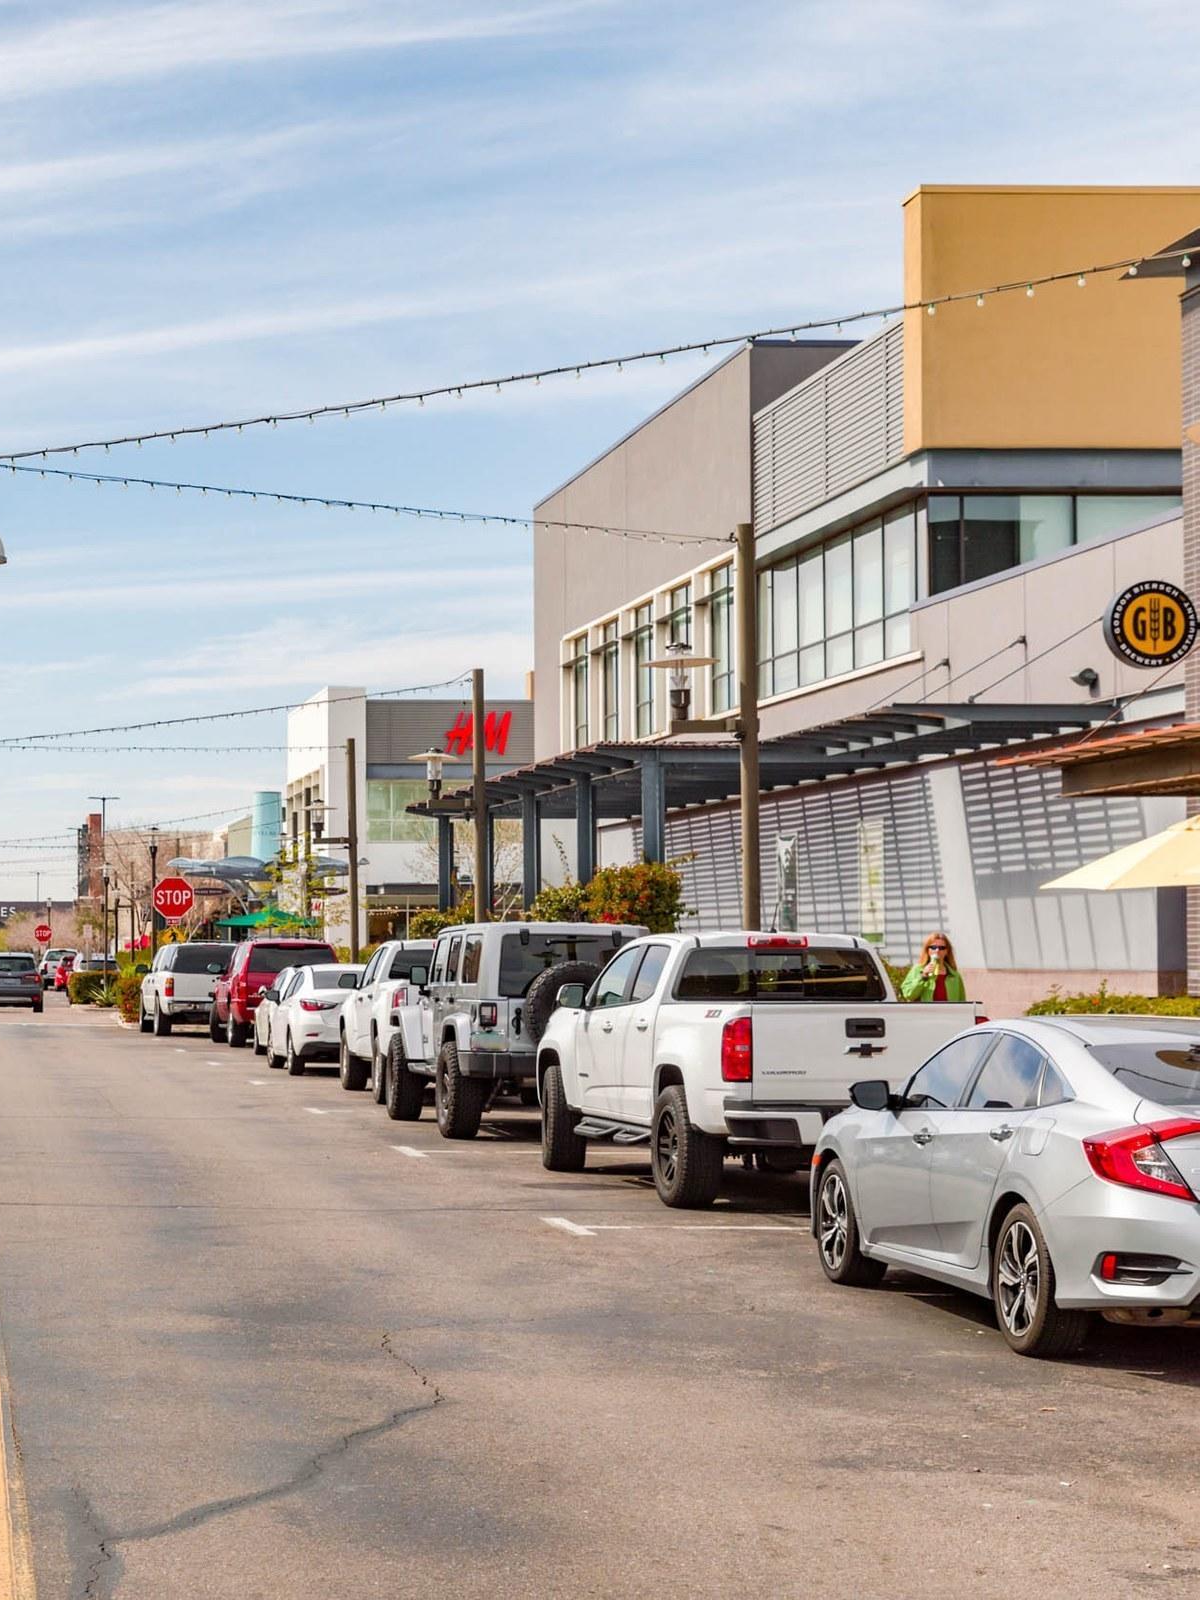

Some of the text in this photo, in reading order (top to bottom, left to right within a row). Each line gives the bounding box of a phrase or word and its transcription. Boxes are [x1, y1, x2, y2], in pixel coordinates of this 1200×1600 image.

[1112, 582, 1179, 634] GORDON BIERSCH
[1171, 600, 1197, 660] RESTAURANT
[1119, 643, 1164, 666] BREWERY
[444, 710, 512, 756] HM
[156, 889, 191, 905] STOP
